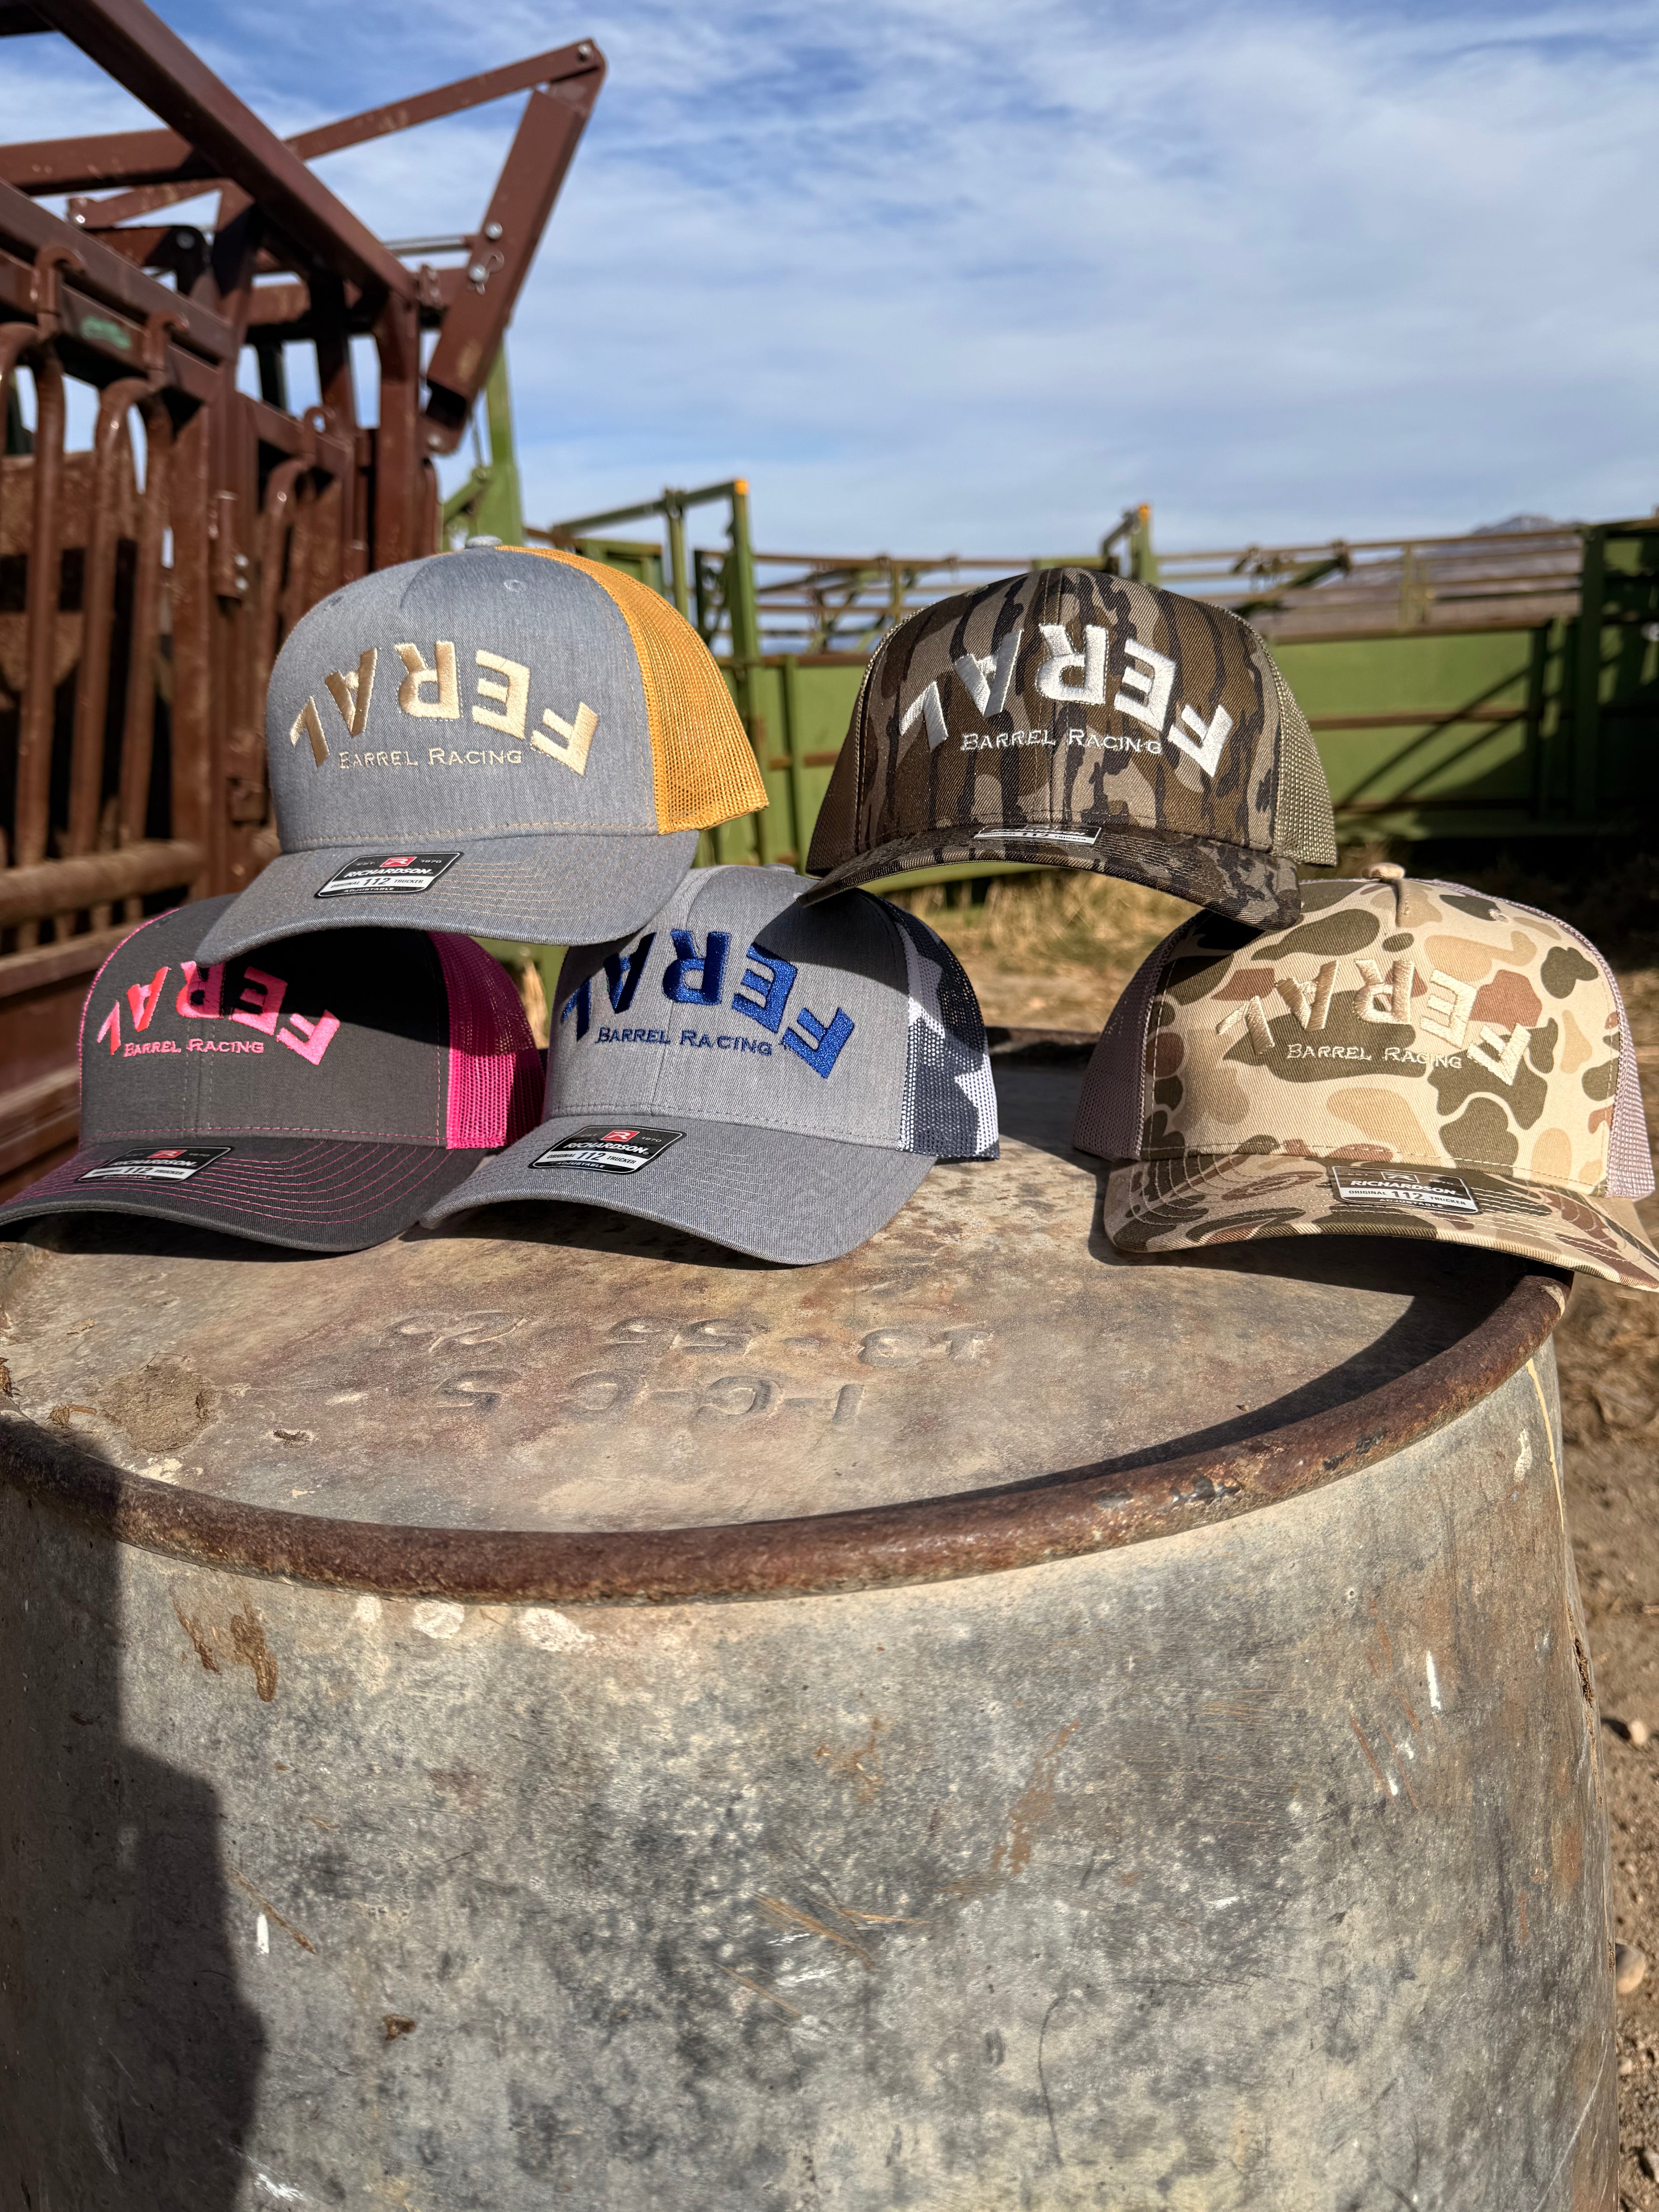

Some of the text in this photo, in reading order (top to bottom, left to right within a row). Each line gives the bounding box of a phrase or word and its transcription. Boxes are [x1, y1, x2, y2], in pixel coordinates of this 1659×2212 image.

[289, 641, 600, 775] FERAL
[899, 624, 1233, 777] FERAL
[961, 729, 1163, 754] BARREL RACING
[339, 747, 522, 769] BARREL RACING
[344, 868, 432, 878] RICHARDSON
[362, 877, 391, 886] 112
[123, 1038, 264, 1058] BARREL RACING
[595, 1027, 772, 1056] BARREL RACING
[1287, 1044, 1462, 1068] BARREL RACING
[563, 1143, 648, 1154] RICHARDSON
[577, 1152, 606, 1161] 112
[607, 1156, 636, 1164] TRUCKER
[1350, 1180, 1457, 1195] RICHARDSON
[1379, 1198, 1443, 1208] ADJUSTABLE
[1391, 1191, 1425, 1200] 112
[1430, 1196, 1466, 1205] TRUCKER
